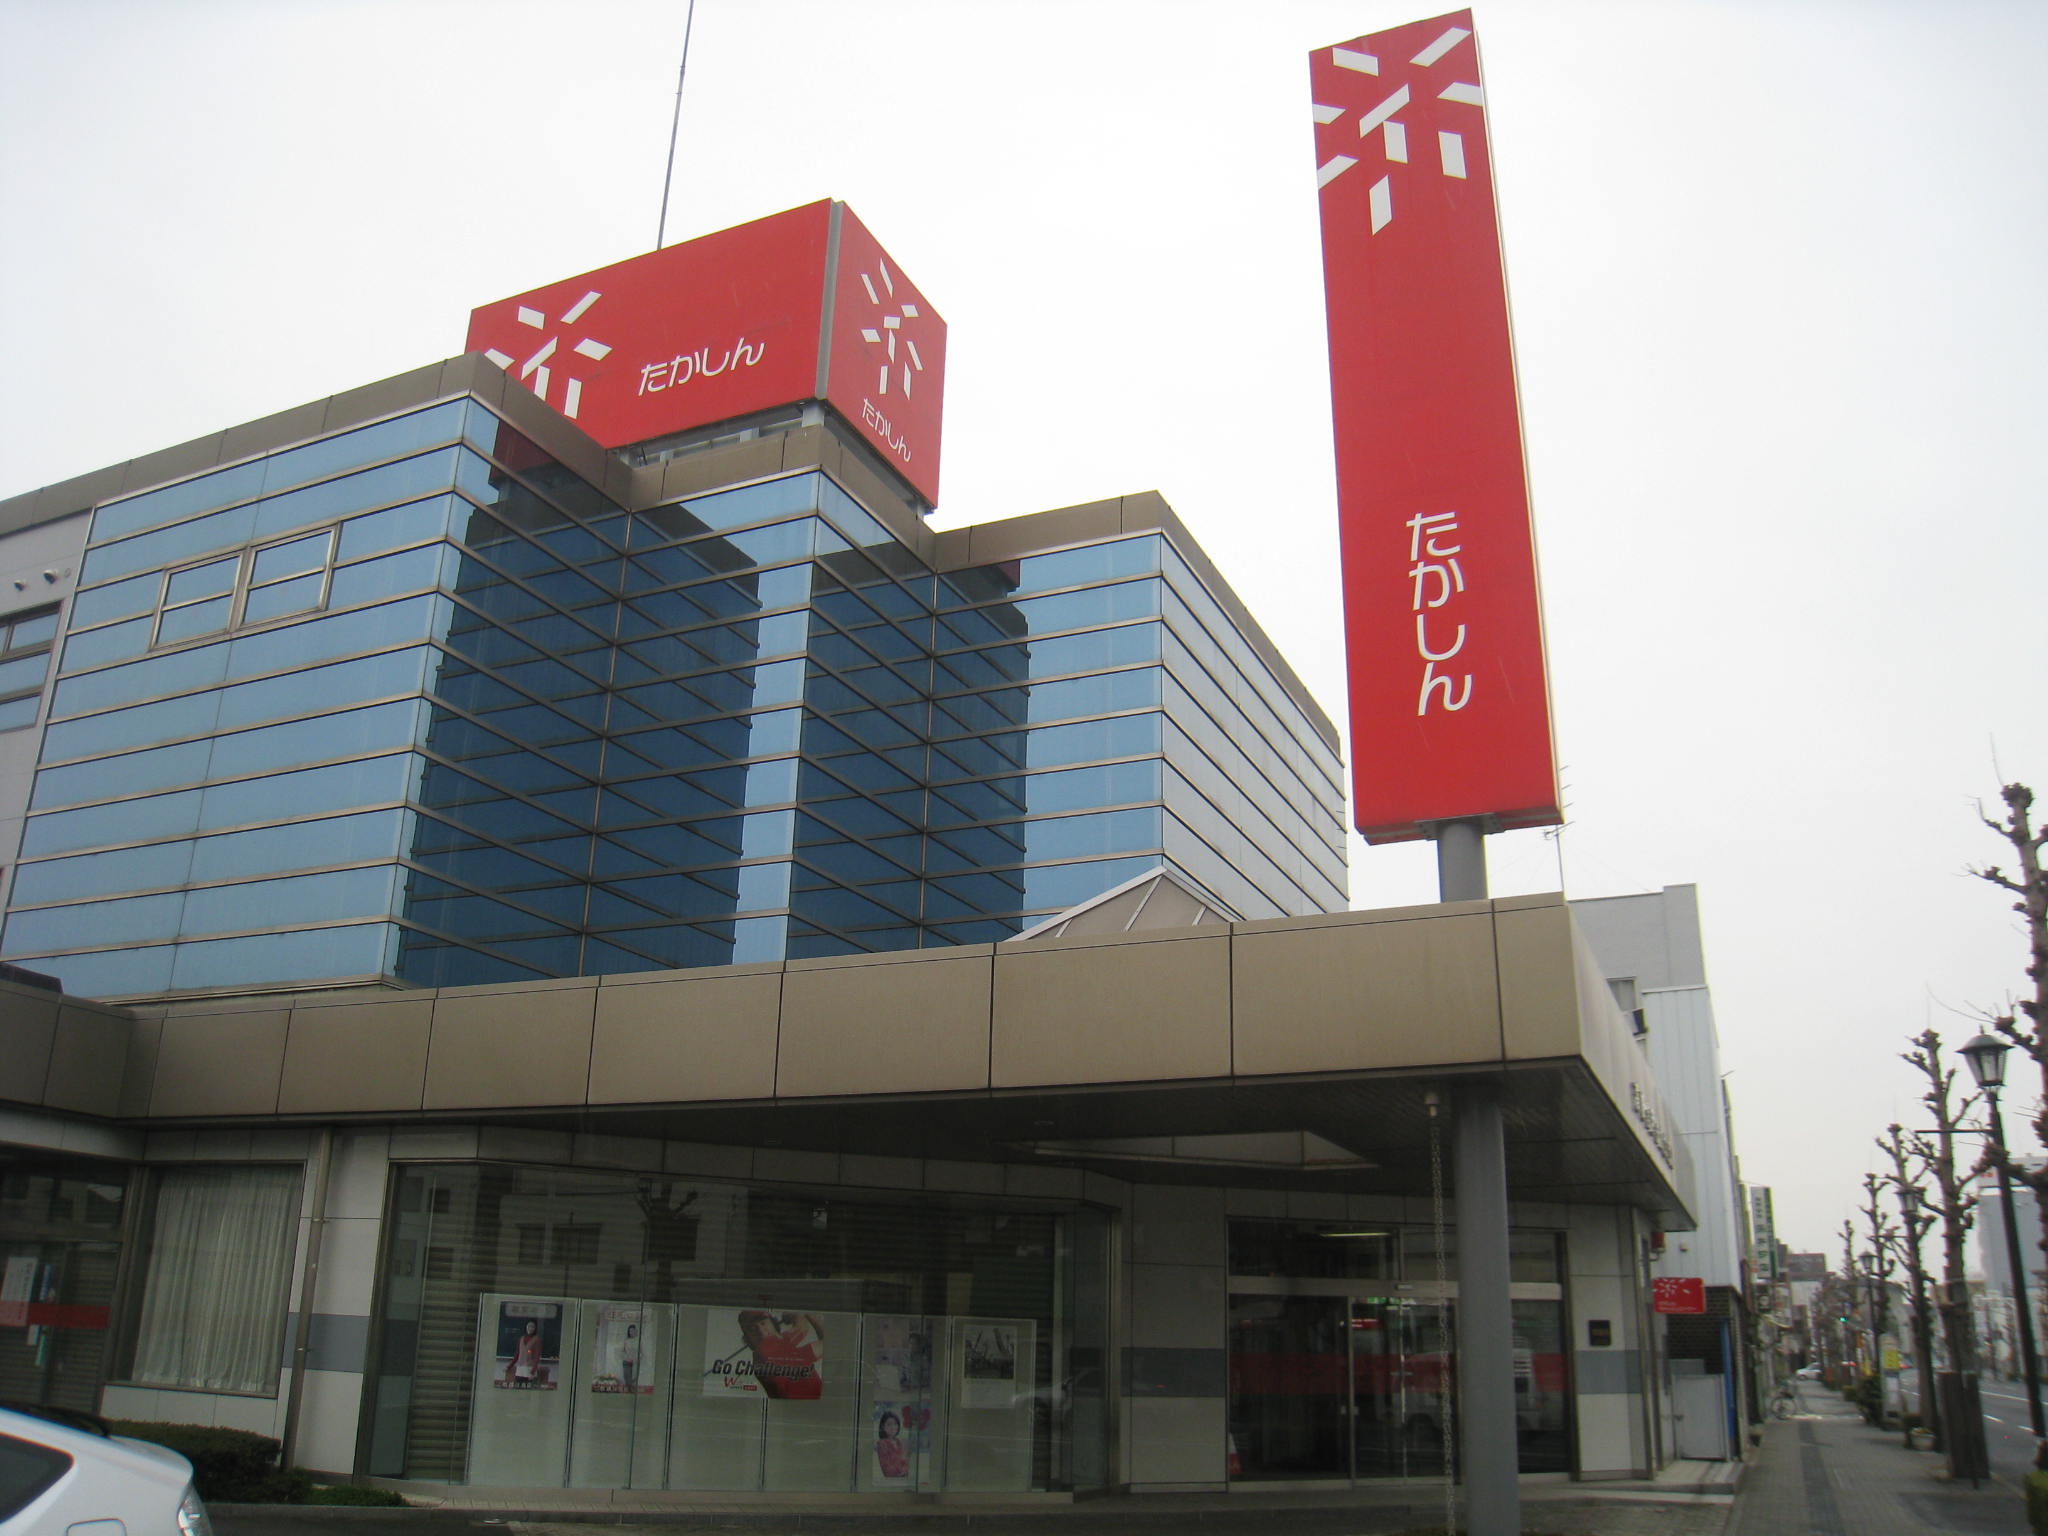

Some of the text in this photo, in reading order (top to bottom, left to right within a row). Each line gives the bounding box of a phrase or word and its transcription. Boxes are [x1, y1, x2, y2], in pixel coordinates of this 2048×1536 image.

[639, 338, 765, 396] たかしん
[862, 397, 912, 463] たかしん
[1406, 512, 1473, 717] たかしん
[712, 1359, 814, 1381] Go Challenge!
